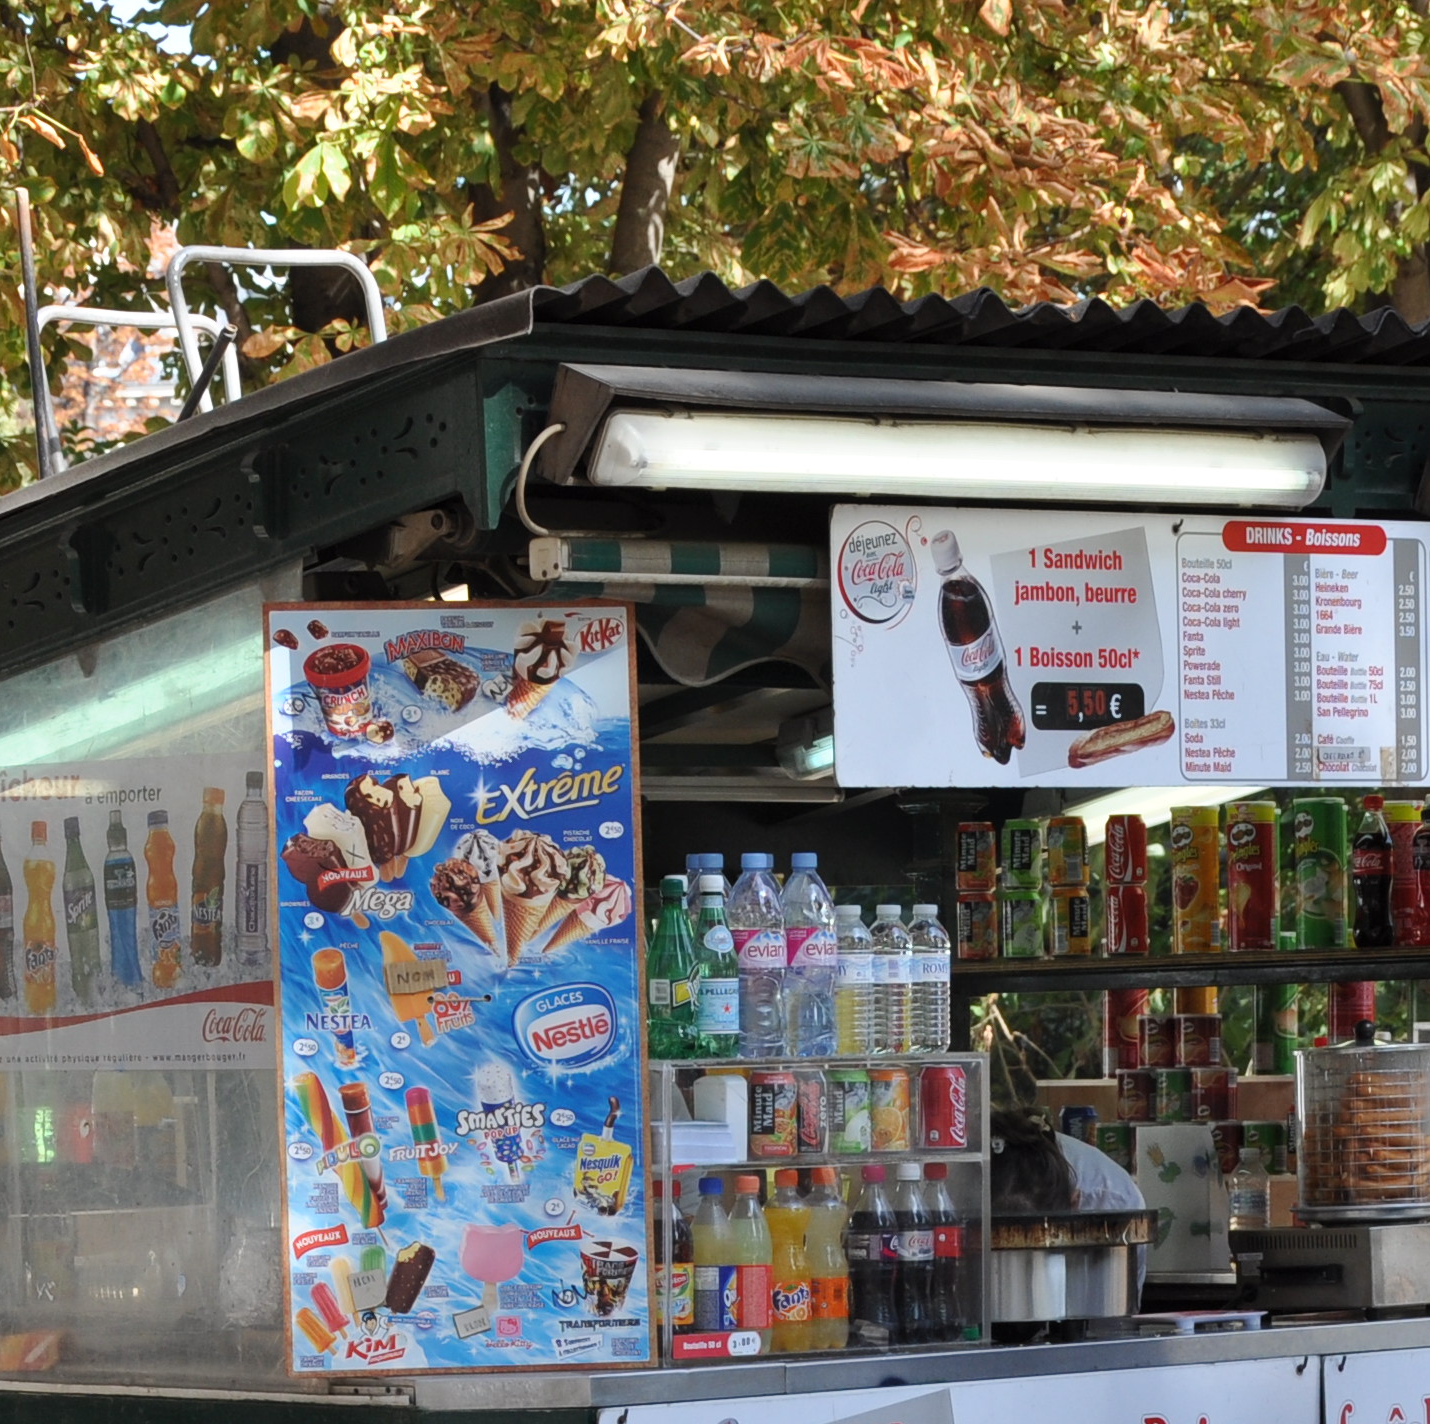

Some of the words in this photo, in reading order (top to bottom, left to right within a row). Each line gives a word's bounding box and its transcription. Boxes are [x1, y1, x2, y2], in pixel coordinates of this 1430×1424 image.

[848, 532, 897, 554] déjeunez
[1246, 528, 1292, 544] DRINKS
[1305, 528, 1360, 547] Boissons
[1029, 549, 1036, 568] 1
[1044, 549, 1122, 570] Sandwich
[1182, 559, 1215, 569] Bouteille
[1182, 573, 1220, 584] Coca-Cola
[1014, 581, 1080, 606] jambon,
[1085, 583, 1137, 603] beurre
[1315, 583, 1348, 593] Heineken
[1182, 588, 1221, 598] Coca-Cola
[1222, 590, 1246, 601] cherry
[1183, 603, 1221, 613] Coca-Cola
[1223, 605, 1239, 613] zero
[1316, 611, 1333, 620] 1664
[1183, 617, 1221, 627] Coca-Cola
[1223, 618, 1240, 629] light
[1316, 625, 1342, 635] Grande
[1344, 624, 1362, 635] Bière
[1183, 632, 1203, 642] Fanta
[384, 630, 465, 664] MAXIBON
[1183, 646, 1205, 657] Sprite
[1015, 649, 1022, 667] 1
[1030, 648, 1093, 668] Boisson
[1184, 661, 1220, 671] Powerade
[1184, 675, 1204, 685] Fanta
[1205, 675, 1221, 685] Still
[324, 687, 365, 705] CRUNCH
[1184, 690, 1210, 700] Nestea
[1212, 689, 1235, 700] Pêche
[1317, 707, 1331, 717] San
[1333, 707, 1368, 719] Pellegrino
[1185, 734, 1203, 743] Soda
[1318, 734, 1334, 745] Café
[1186, 762, 1212, 772] Minute
[1214, 762, 1231, 773] Maid
[97, 786, 162, 806] emporter
[323, 870, 368, 882] NOUVEAUX
[68, 891, 93, 923] Sprite
[342, 887, 412, 918] Mega
[748, 943, 784, 957] evian
[536, 991, 583, 1012] GLACES
[306, 1013, 371, 1030] NESTEA
[25, 1055, 59, 1063] activité
[62, 1054, 99, 1066] physique
[754, 1086, 762, 1132] Minute
[763, 1092, 772, 1126] Maid
[834, 1091, 844, 1124] Maid
[484, 1129, 502, 1139] POP
[505, 1127, 519, 1136] UP
[580, 1155, 620, 1171] Nesquik
[597, 1172, 618, 1184] GO!
[296, 1231, 341, 1248] NOUVEAUX
[531, 1228, 576, 1242] NOUVEAUX
